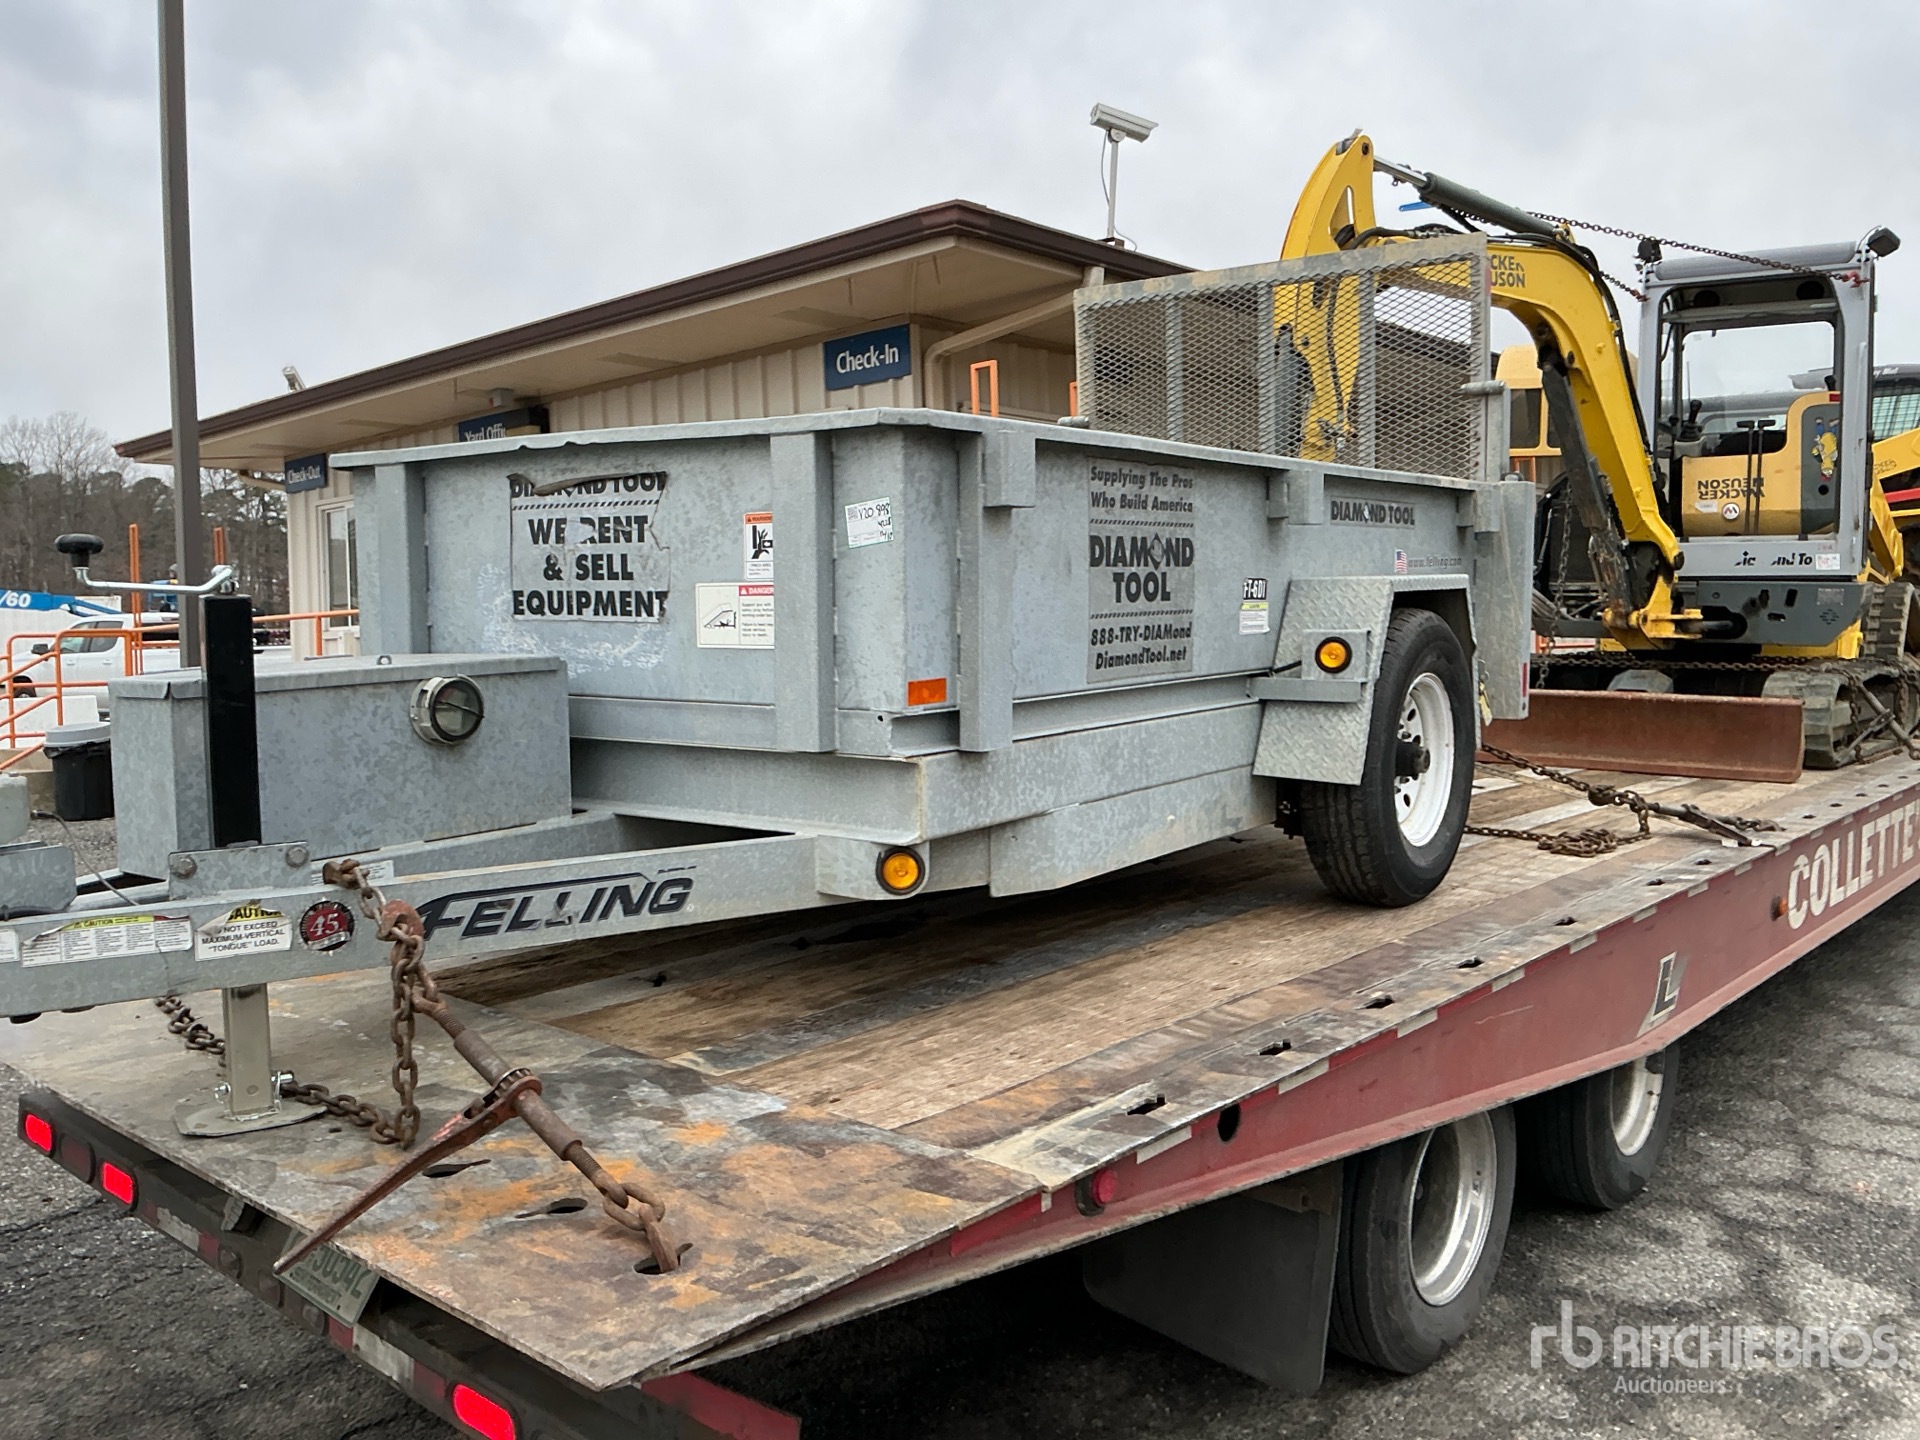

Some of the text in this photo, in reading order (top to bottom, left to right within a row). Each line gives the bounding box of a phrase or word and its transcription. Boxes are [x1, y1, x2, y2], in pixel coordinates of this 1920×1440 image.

[1491, 254, 1525, 272] CKE
[1490, 271, 1526, 288] USON
[836, 344, 899, 373] Check-In
[287, 465, 321, 484] Check-Out
[1091, 466, 1193, 489] Supplying The Pros
[1091, 491, 1193, 513] Who Build America
[1330, 500, 1415, 526] DIAMOND TOOL
[528, 517, 568, 545] WE
[1089, 532, 1195, 571] DIAMOND
[543, 553, 634, 581] & SELL
[1112, 571, 1171, 604] TOOL
[512, 589, 670, 617] EQUIPMENT
[1091, 621, 1192, 646] 888-TRY-DIAMond
[1096, 645, 1187, 670] DiamondTool.net
[1787, 800, 1920, 929] COLLETTE
[416, 872, 694, 941] FELLING
[202, 928, 285, 945] MAXIMUM-VERTICAL
[223, 920, 278, 933] NOT EXCEED
[309, 912, 341, 937] 45
[254, 938, 279, 948] LOAD.
